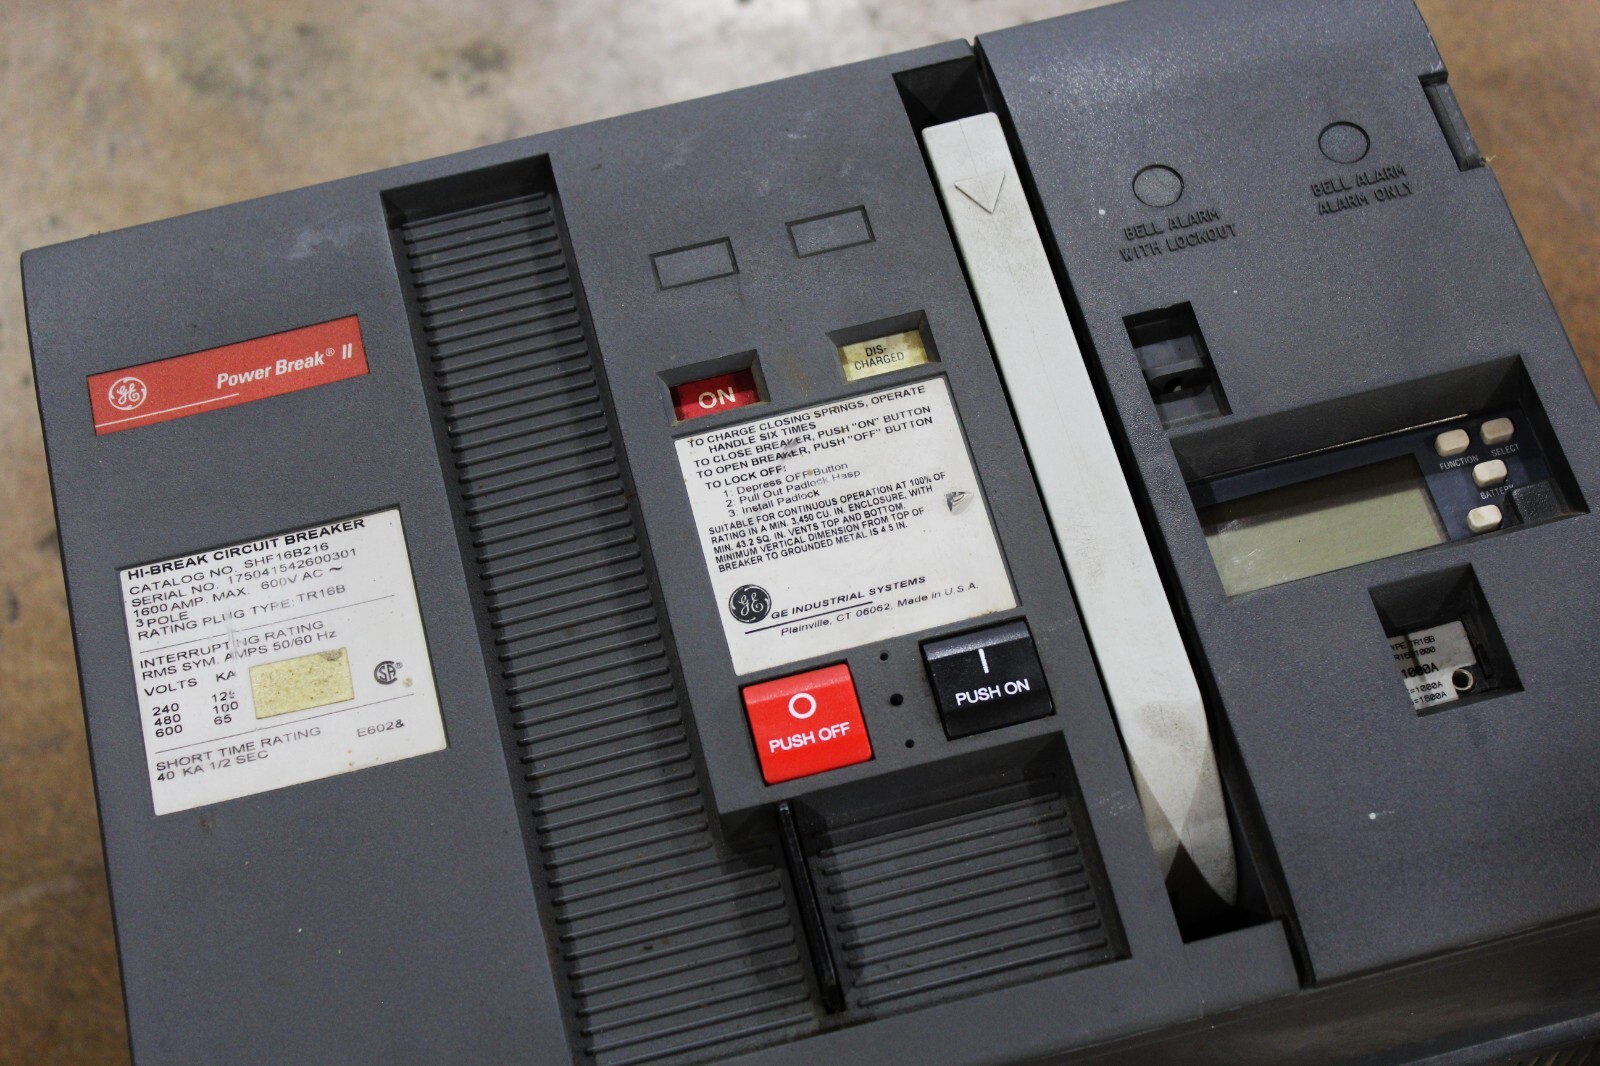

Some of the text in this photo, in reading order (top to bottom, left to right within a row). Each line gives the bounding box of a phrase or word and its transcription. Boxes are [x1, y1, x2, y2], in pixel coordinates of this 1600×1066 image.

[1311, 165, 1407, 197] BELL ALARM
[1317, 182, 1414, 216] ALARM ONLY
[1124, 208, 1220, 242] BELL ALARM
[1118, 223, 1236, 263] WITH LOCKOUT
[854, 352, 905, 371] CHARGED
[865, 344, 887, 357] DIS-
[217, 364, 271, 389] Power
[698, 386, 737, 409] ON
[688, 386, 925, 448] TO CHARGE CLOSING SPRINGS, OPERATE
[693, 406, 931, 468] TO CLOSE BREAKER, PUSH "ON" BUTTON
[696, 416, 933, 478] TO OPEN BREAKER, PUSH "OFF" BUTTON
[709, 422, 816, 453] HANDLE SIX TIMES
[1491, 443, 1520, 457] SELECT
[705, 465, 786, 490] TO LOCK OFF:
[1440, 454, 1479, 470] FUNCTION
[737, 479, 782, 497] Depress
[785, 470, 810, 482] OFF
[812, 464, 848, 476] Button
[739, 493, 759, 504] Pull
[764, 488, 783, 498] Out
[786, 477, 828, 493] Padlock
[832, 469, 861, 480] Hasp
[709, 472, 946, 535] SUITABLE FOR CONTINUOUS OPERATION AT 100% OF
[711, 485, 933, 544] RATING IN A MIN. 3,450 CU. IN. ENCLOSURE, WITH
[742, 500, 774, 514] Install
[777, 489, 820, 506] Padlock
[714, 503, 905, 554] MIN. 43.2 SQ. IN. VENTS TOP AND BOTTOM.
[715, 507, 924, 564] MINIMUM VERTICAL DIMENSION FROM TOP OF
[129, 520, 365, 580] HI-BREAK CIRCUIT BREAKER
[718, 521, 908, 573] BREAKER TO GROUNDED METAL IS IN.
[130, 542, 329, 595] CATALOG NO. SHF16B216
[132, 548, 356, 607] SERIAL NO. 175041542600301
[133, 604, 167, 617] 1600
[171, 597, 208, 611] AMP.
[261, 574, 297, 589] 600V
[302, 569, 323, 581] AC
[781, 619, 832, 636] Plainville,
[836, 612, 851, 622] CT
[898, 595, 928, 607] Made
[945, 582, 978, 596] U.S.A.
[792, 592, 865, 615] INDUSTRIAL
[869, 576, 925, 595] SYSTEMS
[136, 611, 188, 628] 3 POLE
[138, 620, 197, 640] RATING
[251, 599, 294, 615] TYPE:
[140, 621, 323, 669] INTERRUPTNG RATING
[142, 666, 177, 680] RMS
[225, 645, 268, 662] AMPS
[273, 635, 312, 651] 50/60
[317, 631, 336, 641] Hz
[144, 671, 236, 696] VOLTS KA
[955, 678, 1030, 706] PUSH ON
[152, 703, 179, 716] 240
[154, 701, 238, 726] 480 100
[155, 714, 232, 738] 600 65
[156, 727, 321, 771] SHORT TIME RATING
[768, 721, 850, 753] PUSH OFF
[157, 750, 268, 781] 40 KA 1/2 SEC
